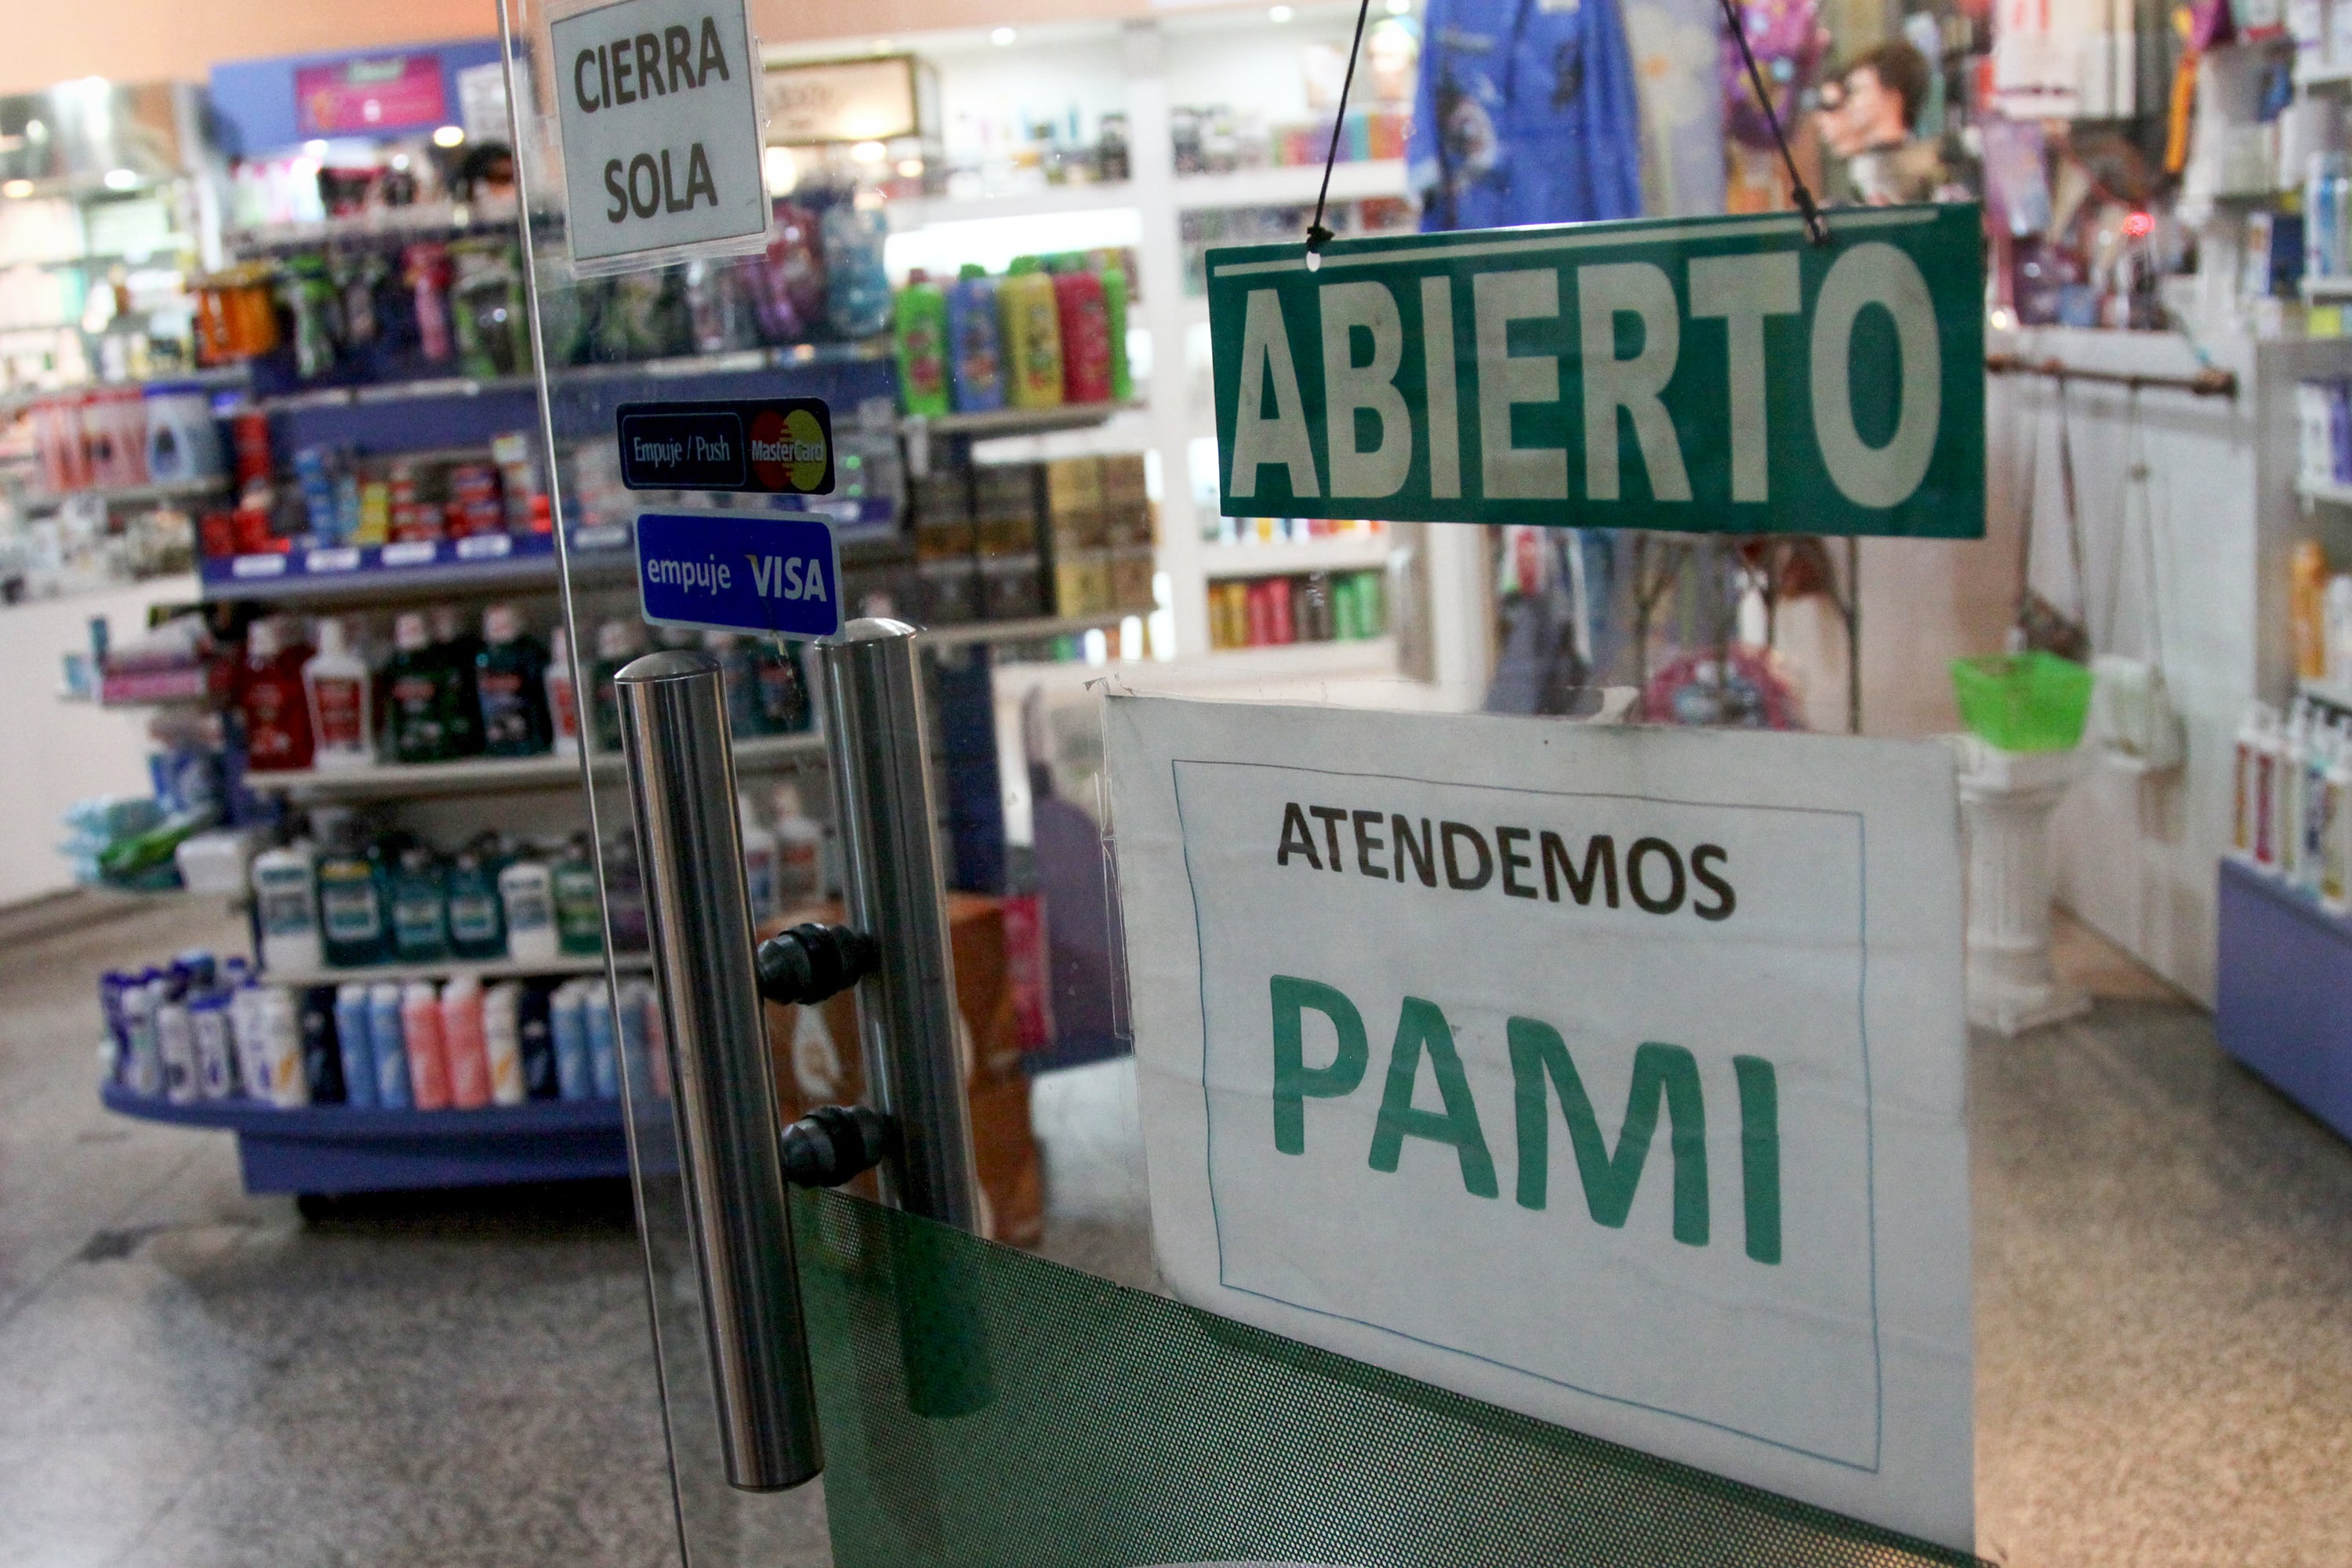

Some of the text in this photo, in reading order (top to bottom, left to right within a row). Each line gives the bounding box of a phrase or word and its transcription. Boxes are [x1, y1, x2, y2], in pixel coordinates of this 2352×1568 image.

[574, 16, 730, 113] CIERRA
[604, 142, 718, 223] SOLA
[1229, 241, 1941, 508] ABIERTO
[633, 437, 682, 467] Empuje
[697, 434, 730, 461] Push
[751, 440, 826, 463] MasterCard
[647, 554, 827, 602] empuje VISA
[1276, 802, 1737, 922] ATENDEMOS
[1270, 975, 1782, 1265] PAMI
